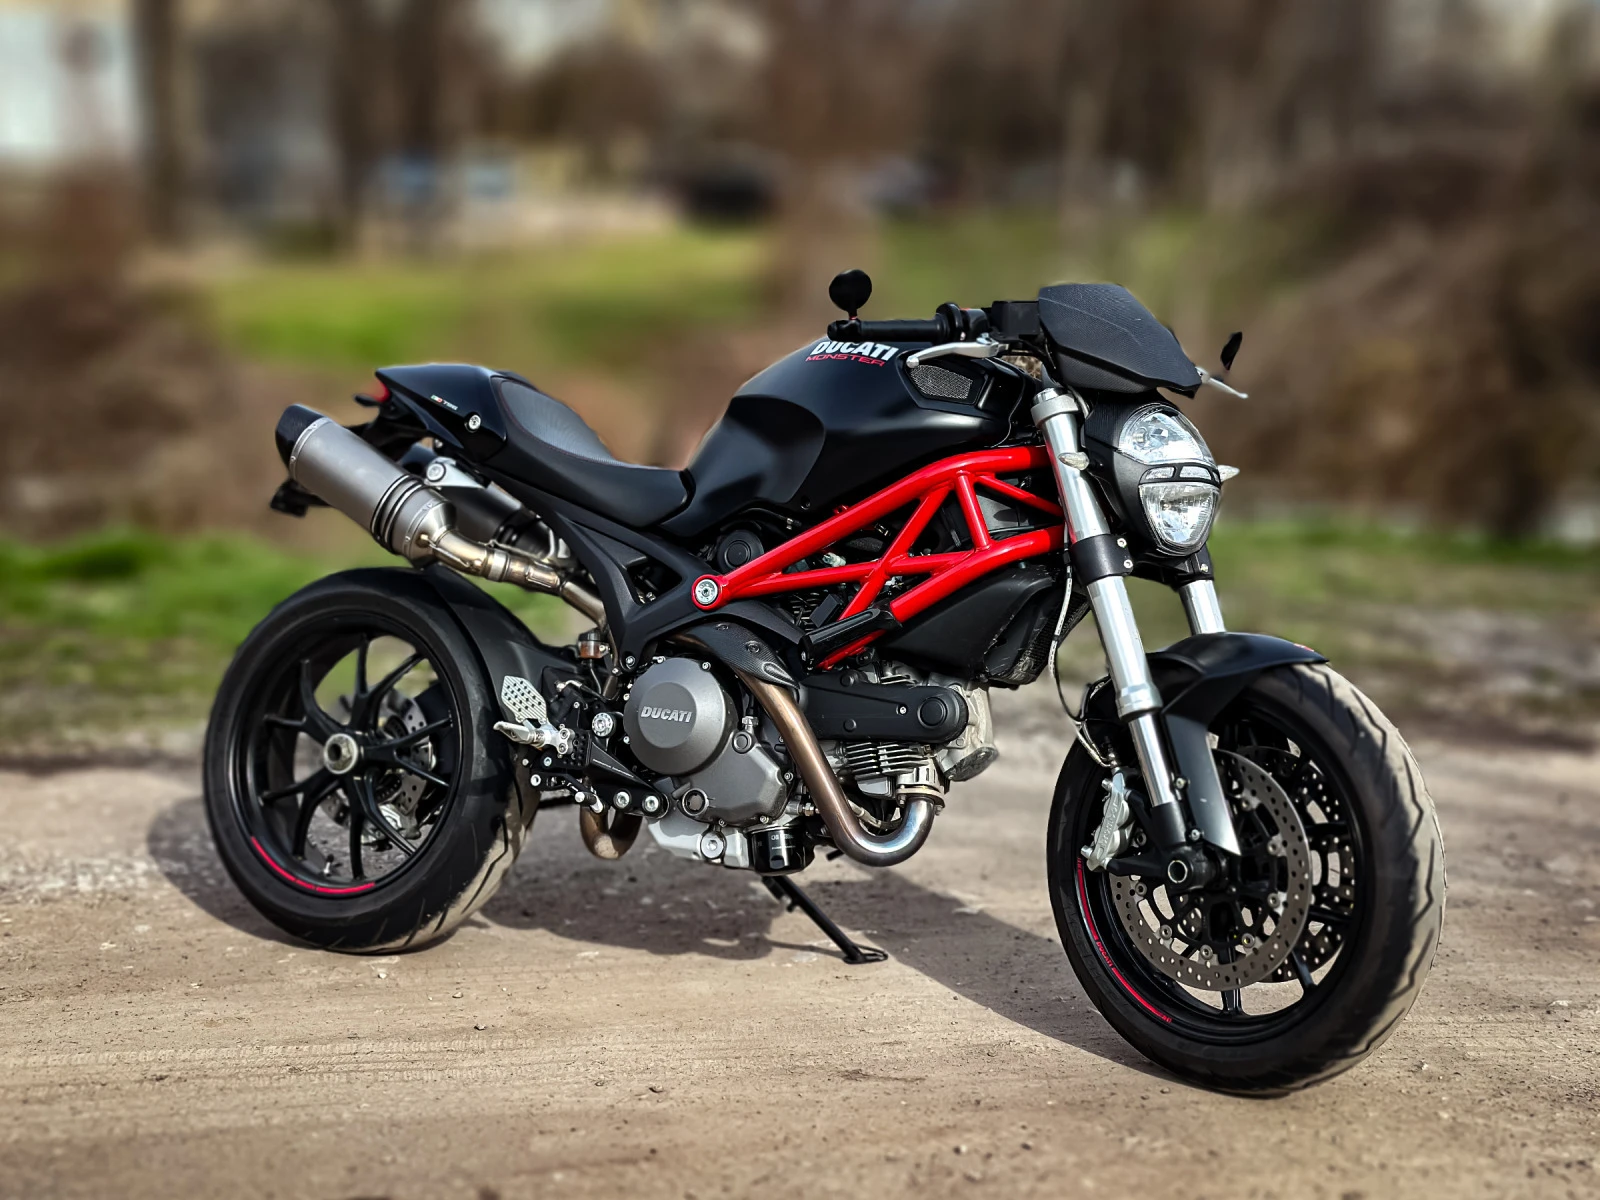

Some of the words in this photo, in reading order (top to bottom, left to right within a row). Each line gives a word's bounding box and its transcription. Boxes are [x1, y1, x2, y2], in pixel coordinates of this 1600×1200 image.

[810, 341, 899, 361] DUCATI
[805, 354, 885, 367] MONSTER
[640, 706, 692, 723] DUCATI
